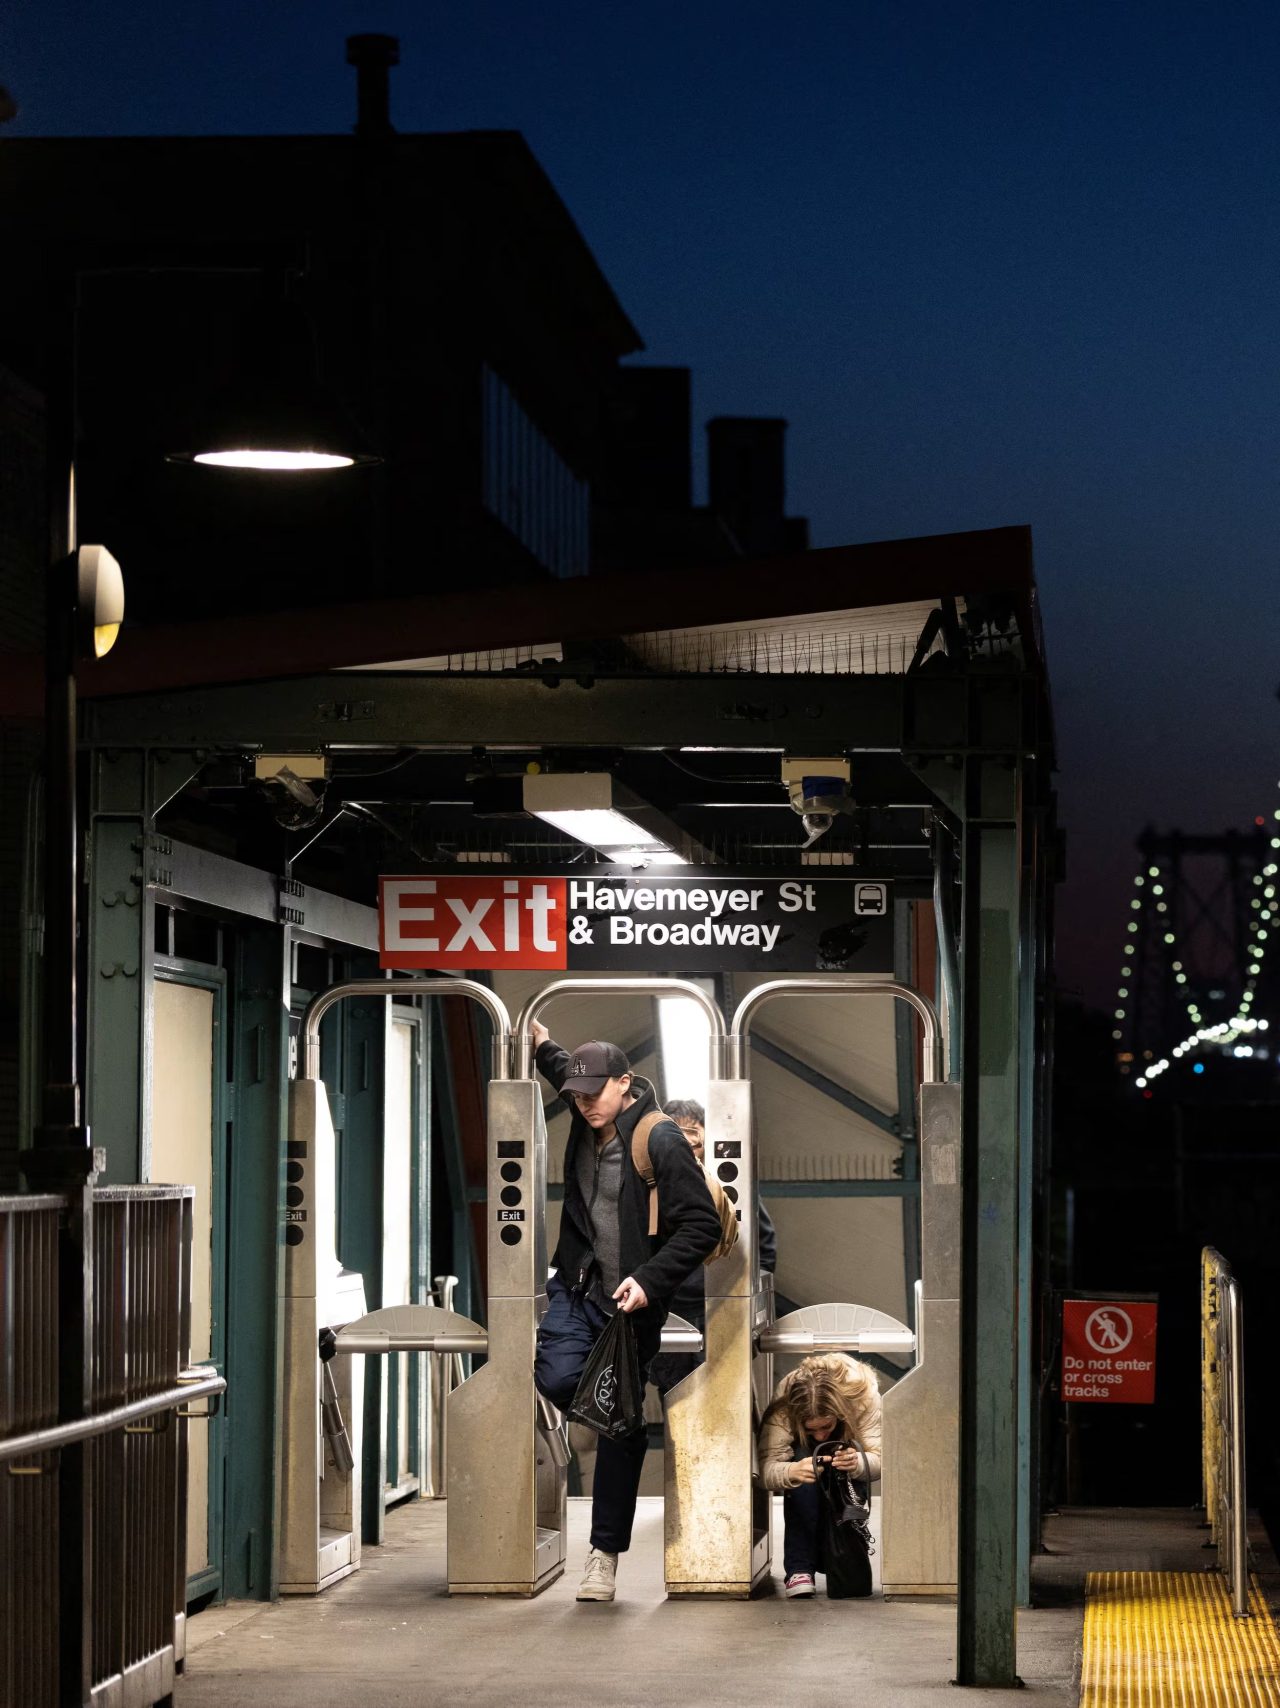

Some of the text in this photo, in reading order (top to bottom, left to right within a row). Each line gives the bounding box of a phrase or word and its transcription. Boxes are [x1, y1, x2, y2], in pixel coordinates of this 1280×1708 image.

[570, 882, 816, 916] Havemeyer St
[383, 880, 557, 953] Exit
[568, 917, 781, 952] & Broadway
[501, 1211, 521, 1221] Exit
[1064, 1356, 1153, 1371] Do not enter
[1064, 1373, 1124, 1384] or cross
[1064, 1384, 1110, 1398] tracks
